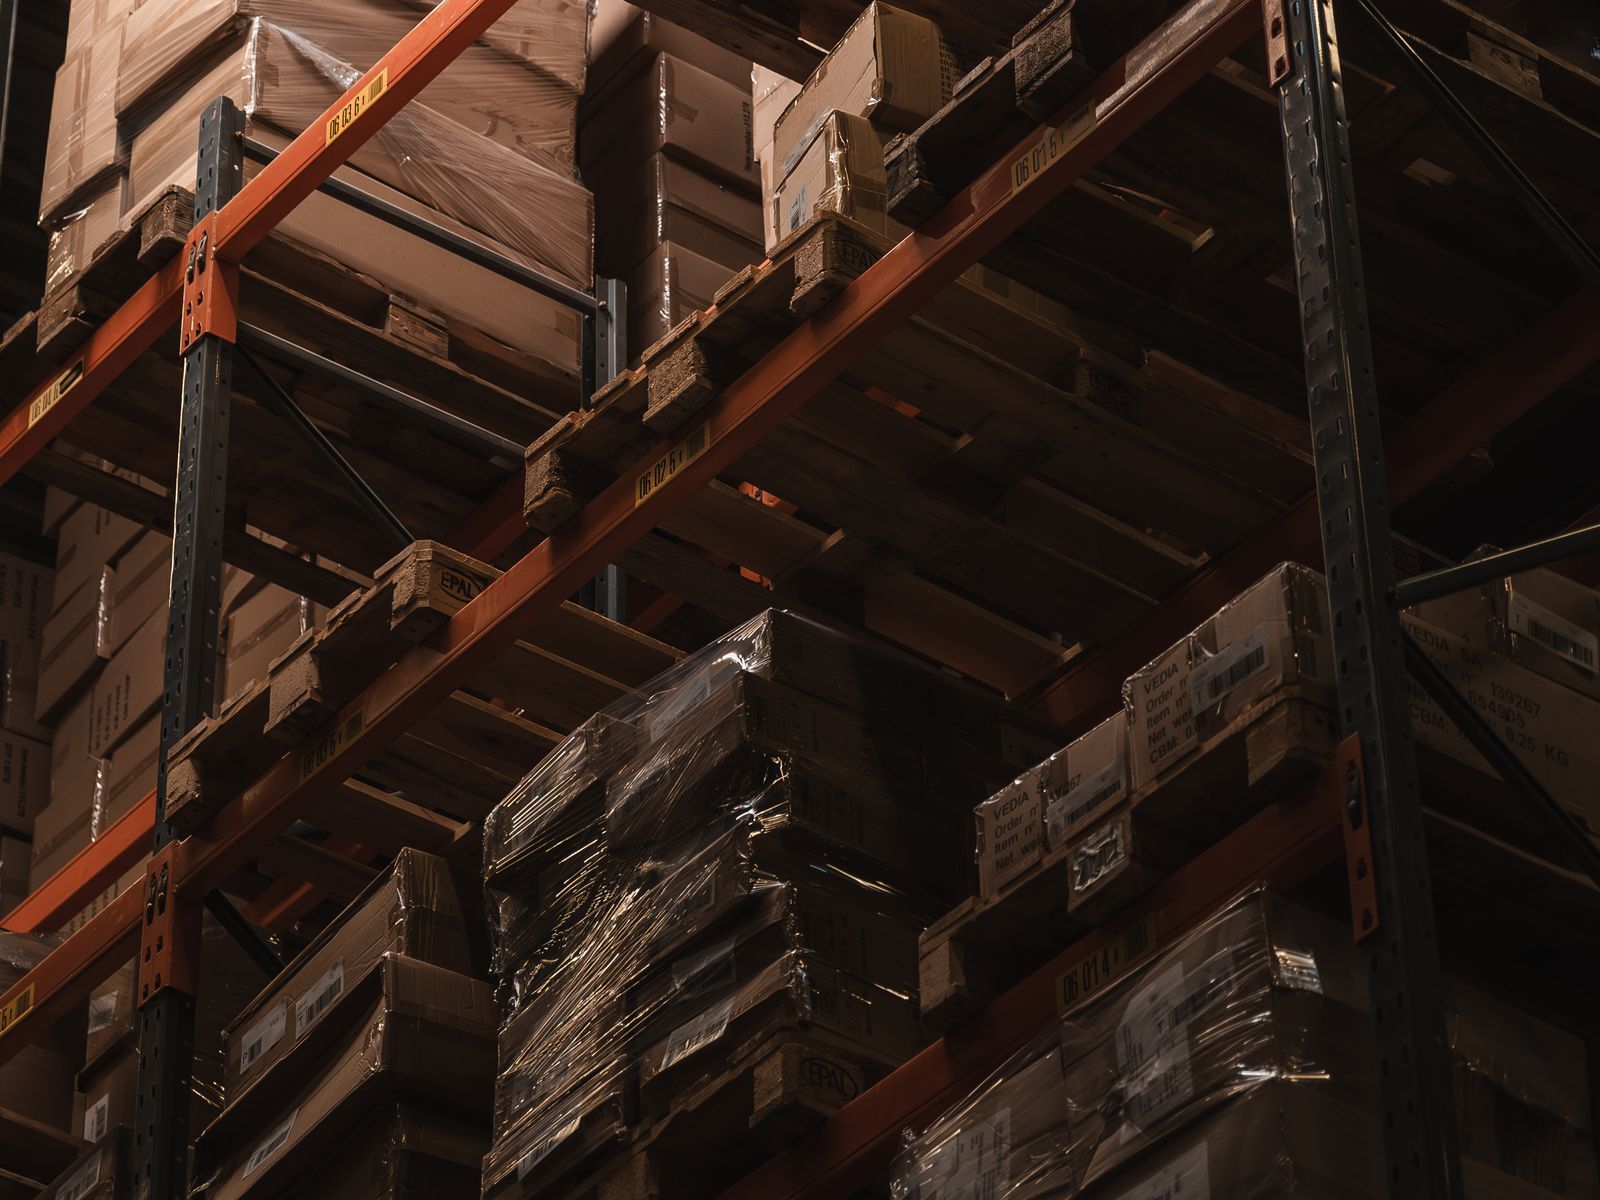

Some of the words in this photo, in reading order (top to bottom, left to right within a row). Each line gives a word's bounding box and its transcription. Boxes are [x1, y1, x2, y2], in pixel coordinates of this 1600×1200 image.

[329, 115, 340, 140] 06
[341, 103, 352, 128] 03
[354, 96, 360, 116] 6
[1015, 156, 1029, 187] 06
[1032, 143, 1047, 173] 01
[1049, 131, 1057, 159] 5
[639, 471, 651, 499] 06
[654, 459, 666, 488] 02
[669, 450, 676, 475] 5
[441, 571, 473, 597] EPAL
[1144, 663, 1179, 695] VEDIA
[1145, 686, 1173, 713] Order
[1146, 706, 1171, 730] Item
[1410, 703, 1450, 733] CBM:
[1148, 726, 1167, 748] Net
[1150, 737, 1179, 765] CBM:
[1545, 743, 1569, 767] KG
[993, 791, 1030, 820] VEDIA
[994, 814, 1024, 838] Order
[994, 833, 1018, 855] Item
[995, 852, 1014, 872] Net
[1063, 969, 1078, 1005] 06
[1083, 955, 1098, 992] 01
[1102, 945, 1110, 978] 4
[809, 1061, 846, 1098] EPAL
